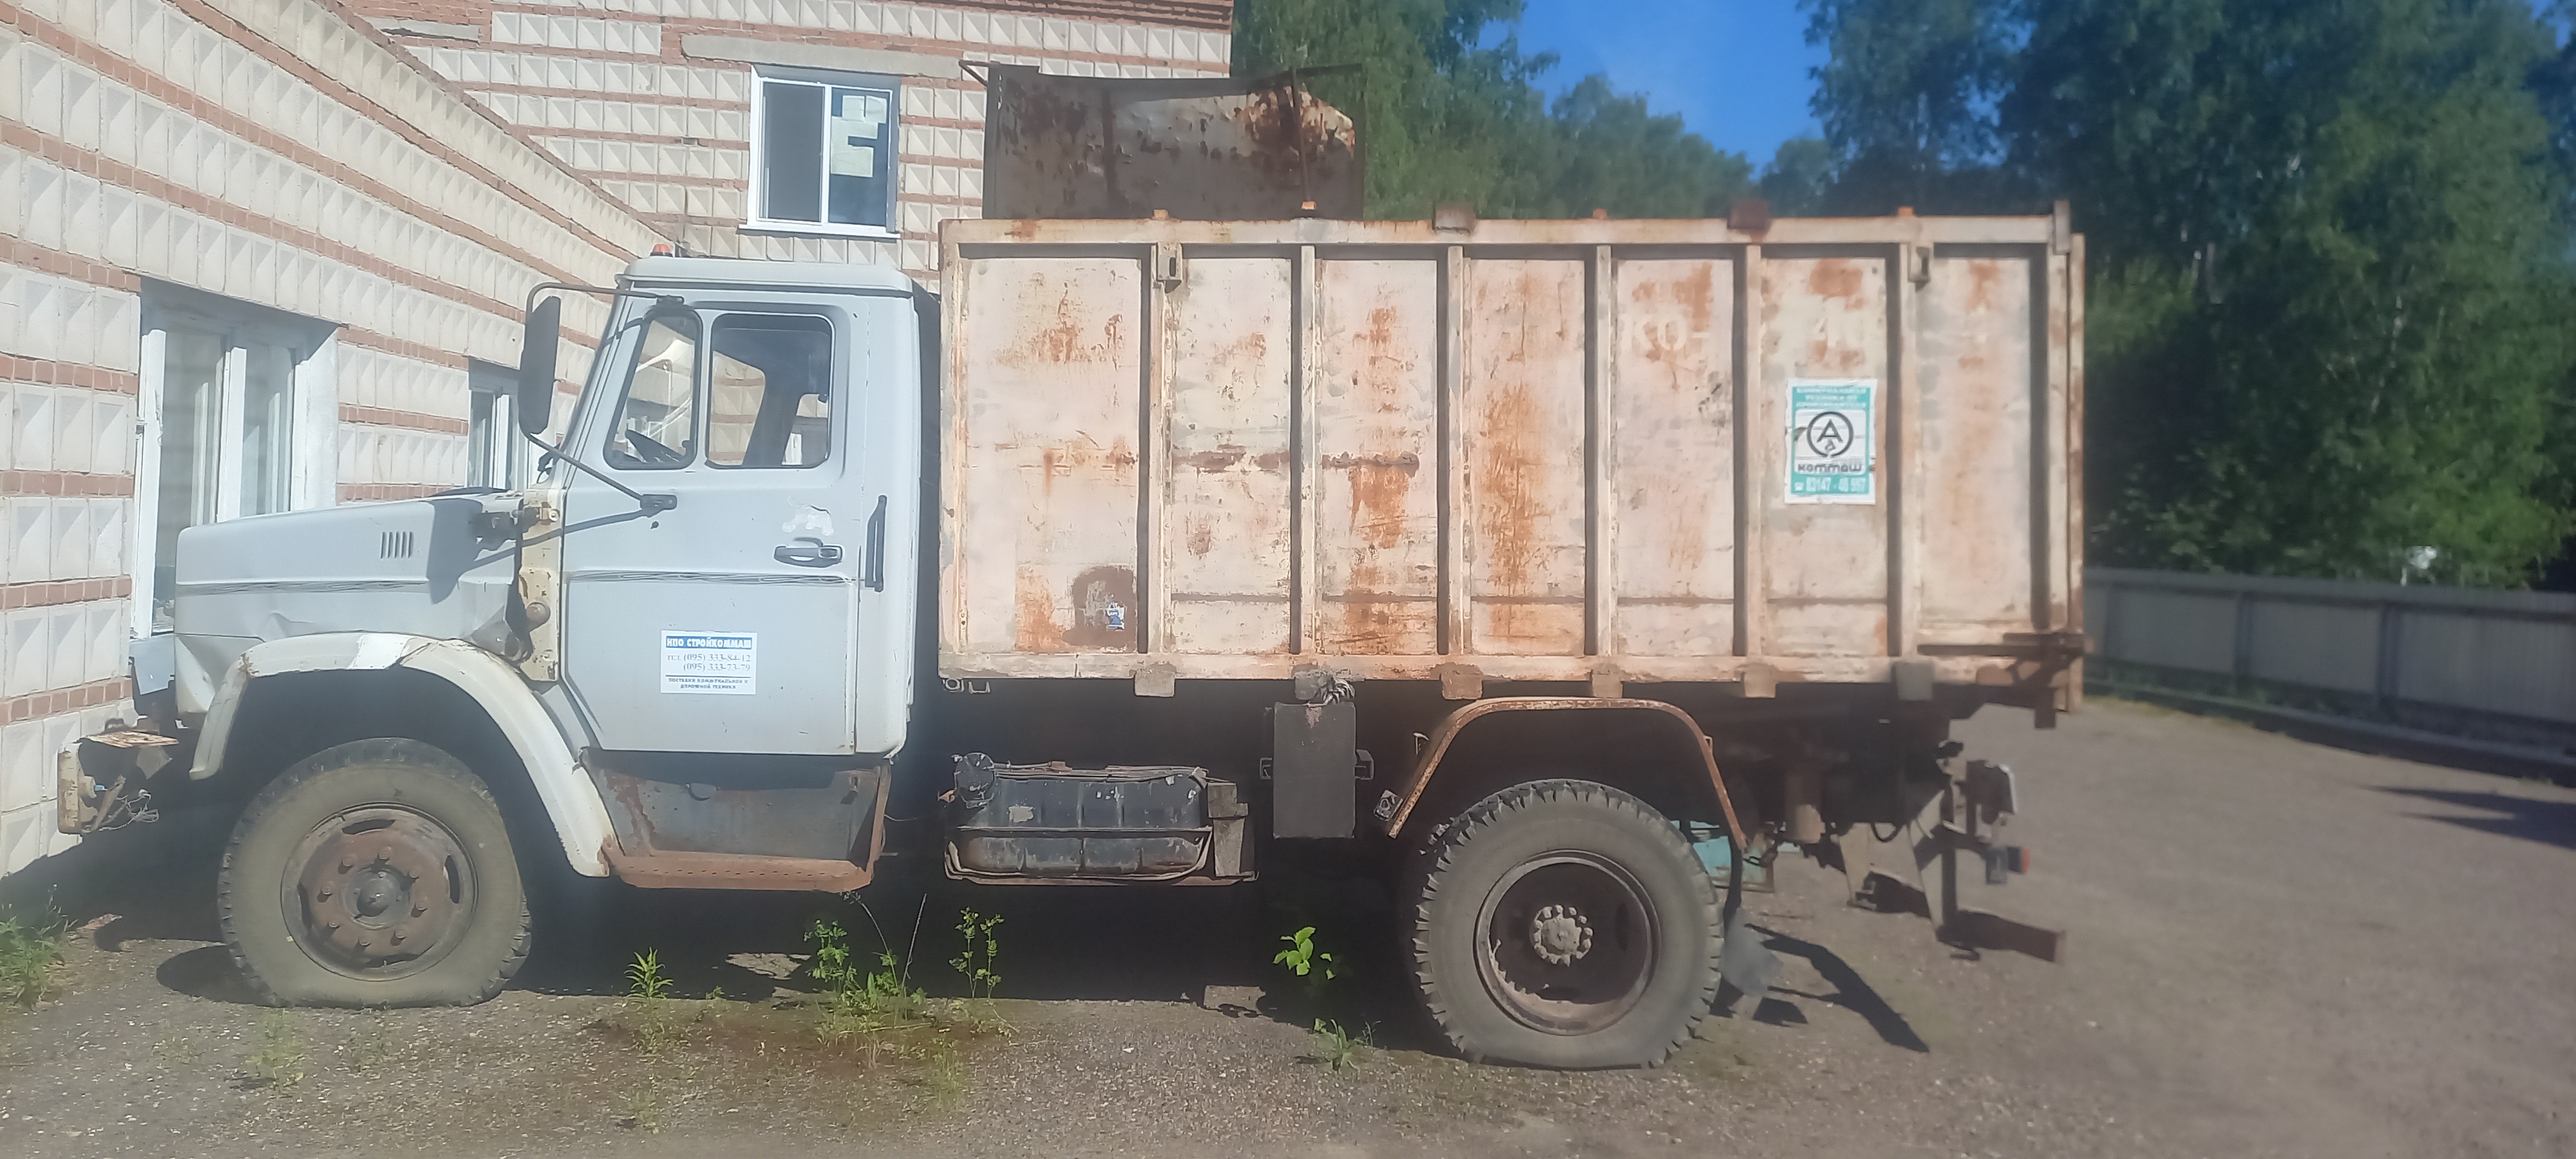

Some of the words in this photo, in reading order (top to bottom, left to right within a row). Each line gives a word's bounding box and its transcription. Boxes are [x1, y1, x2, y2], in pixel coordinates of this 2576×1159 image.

[667, 637, 684, 647] НПО
[683, 653, 706, 662] (095)
[683, 663, 706, 672] (095)
